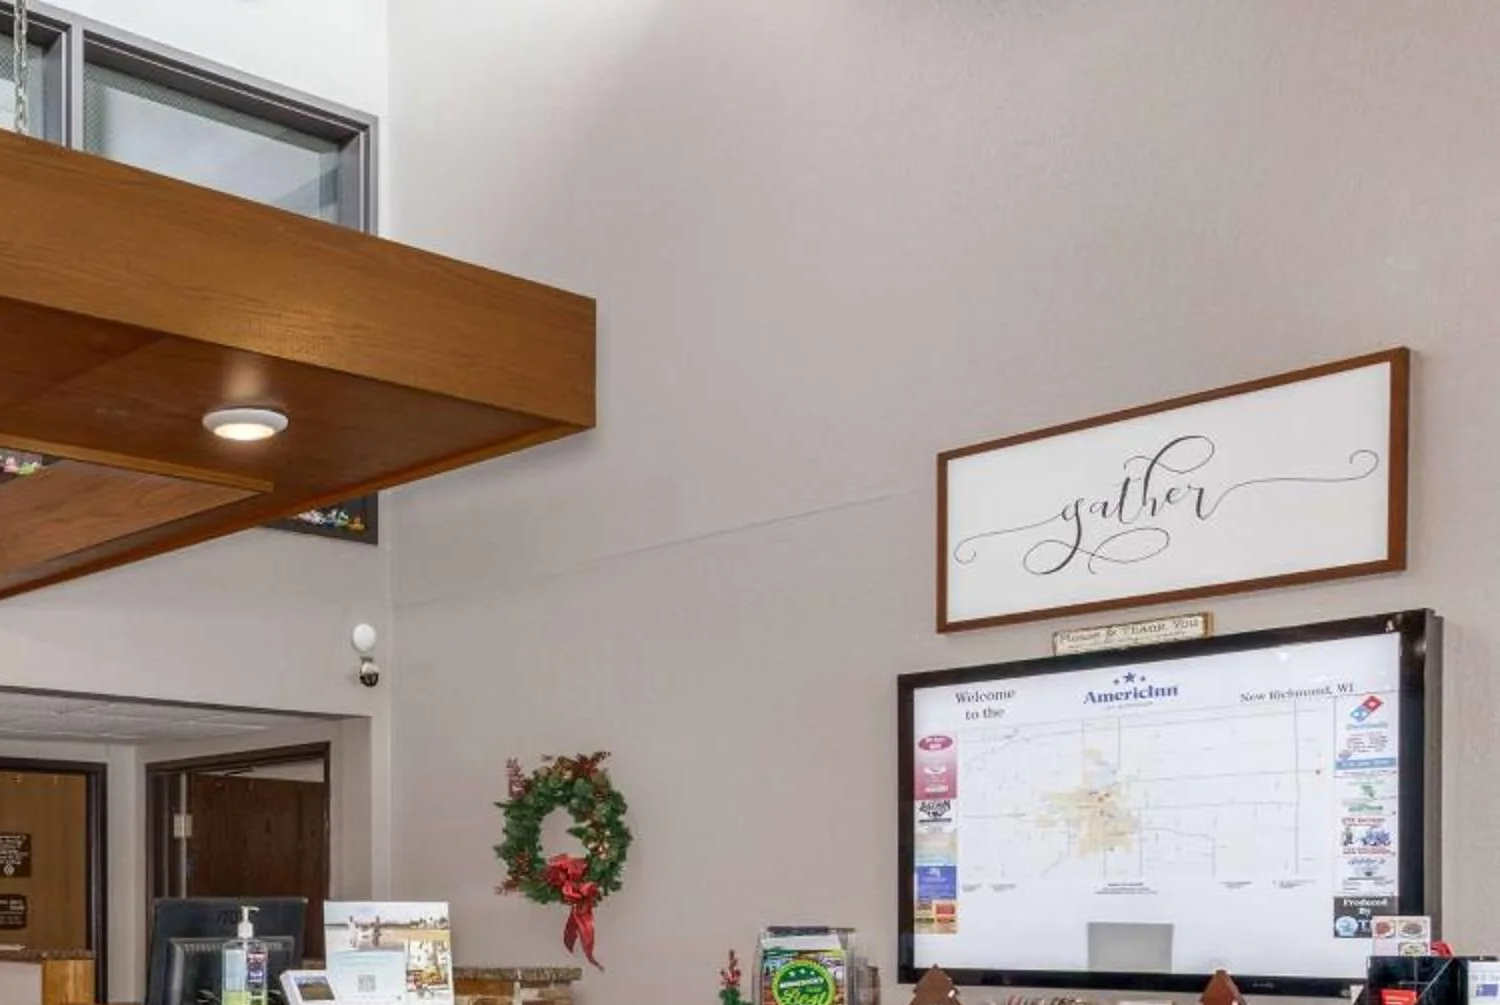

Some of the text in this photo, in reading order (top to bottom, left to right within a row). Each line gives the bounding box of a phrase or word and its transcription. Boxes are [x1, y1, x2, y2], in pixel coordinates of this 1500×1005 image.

[955, 688, 1016, 704] Welcome
[1083, 684, 1179, 705] AmericInn
[1240, 691, 1266, 703] New
[965, 706, 1005, 721] to the
